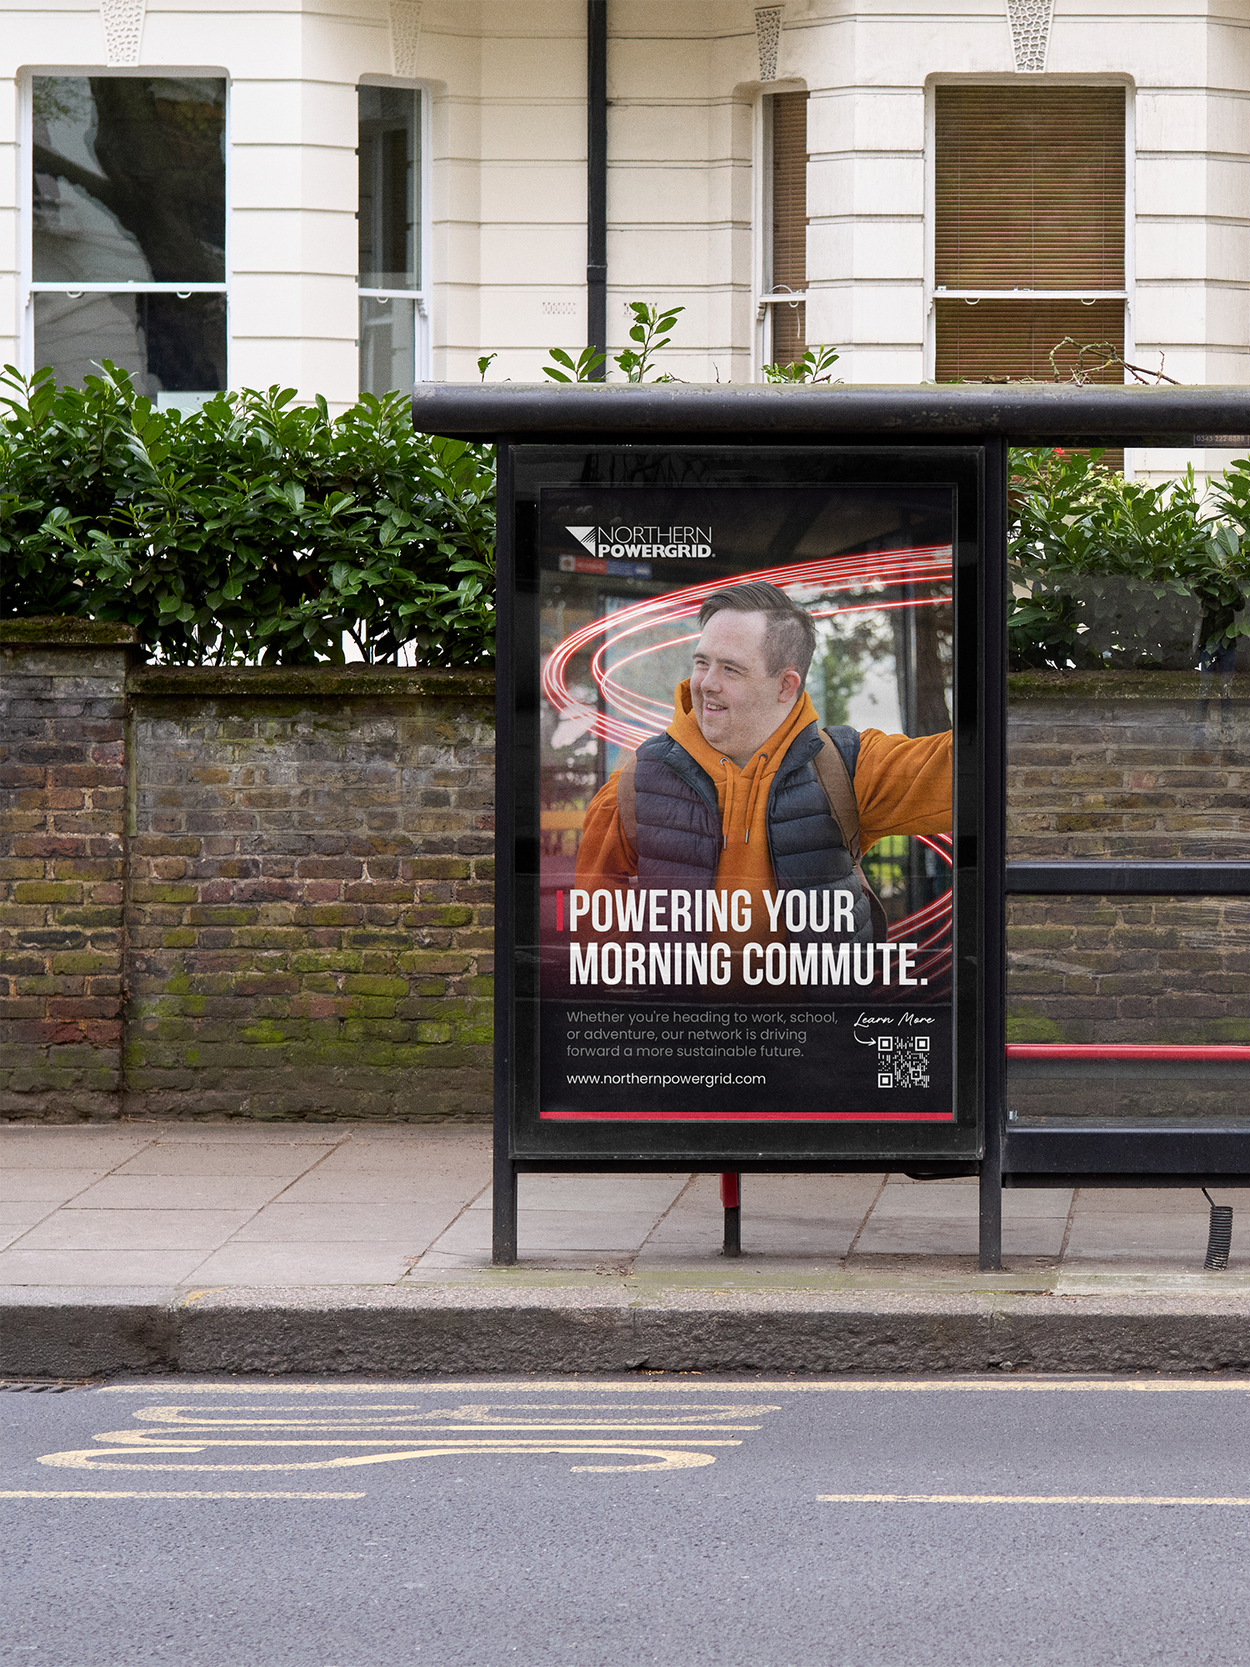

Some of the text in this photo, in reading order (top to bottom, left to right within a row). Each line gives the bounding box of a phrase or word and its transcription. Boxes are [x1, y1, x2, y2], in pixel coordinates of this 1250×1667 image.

[598, 526, 712, 544] NORTHERN
[569, 888, 855, 933] POWERING YOUR
[569, 942, 929, 986] MORNING COMMUTE.
[566, 1011, 838, 1026] Whether you're heading to work, school,
[853, 1012, 935, 1028] Learn More
[566, 1028, 807, 1043] or adventure, our network is driving
[566, 1045, 804, 1057] forward a more sustainable future.
[566, 1073, 766, 1088] www.northernpowergrid.com
[37, 1404, 782, 1473] BUS
